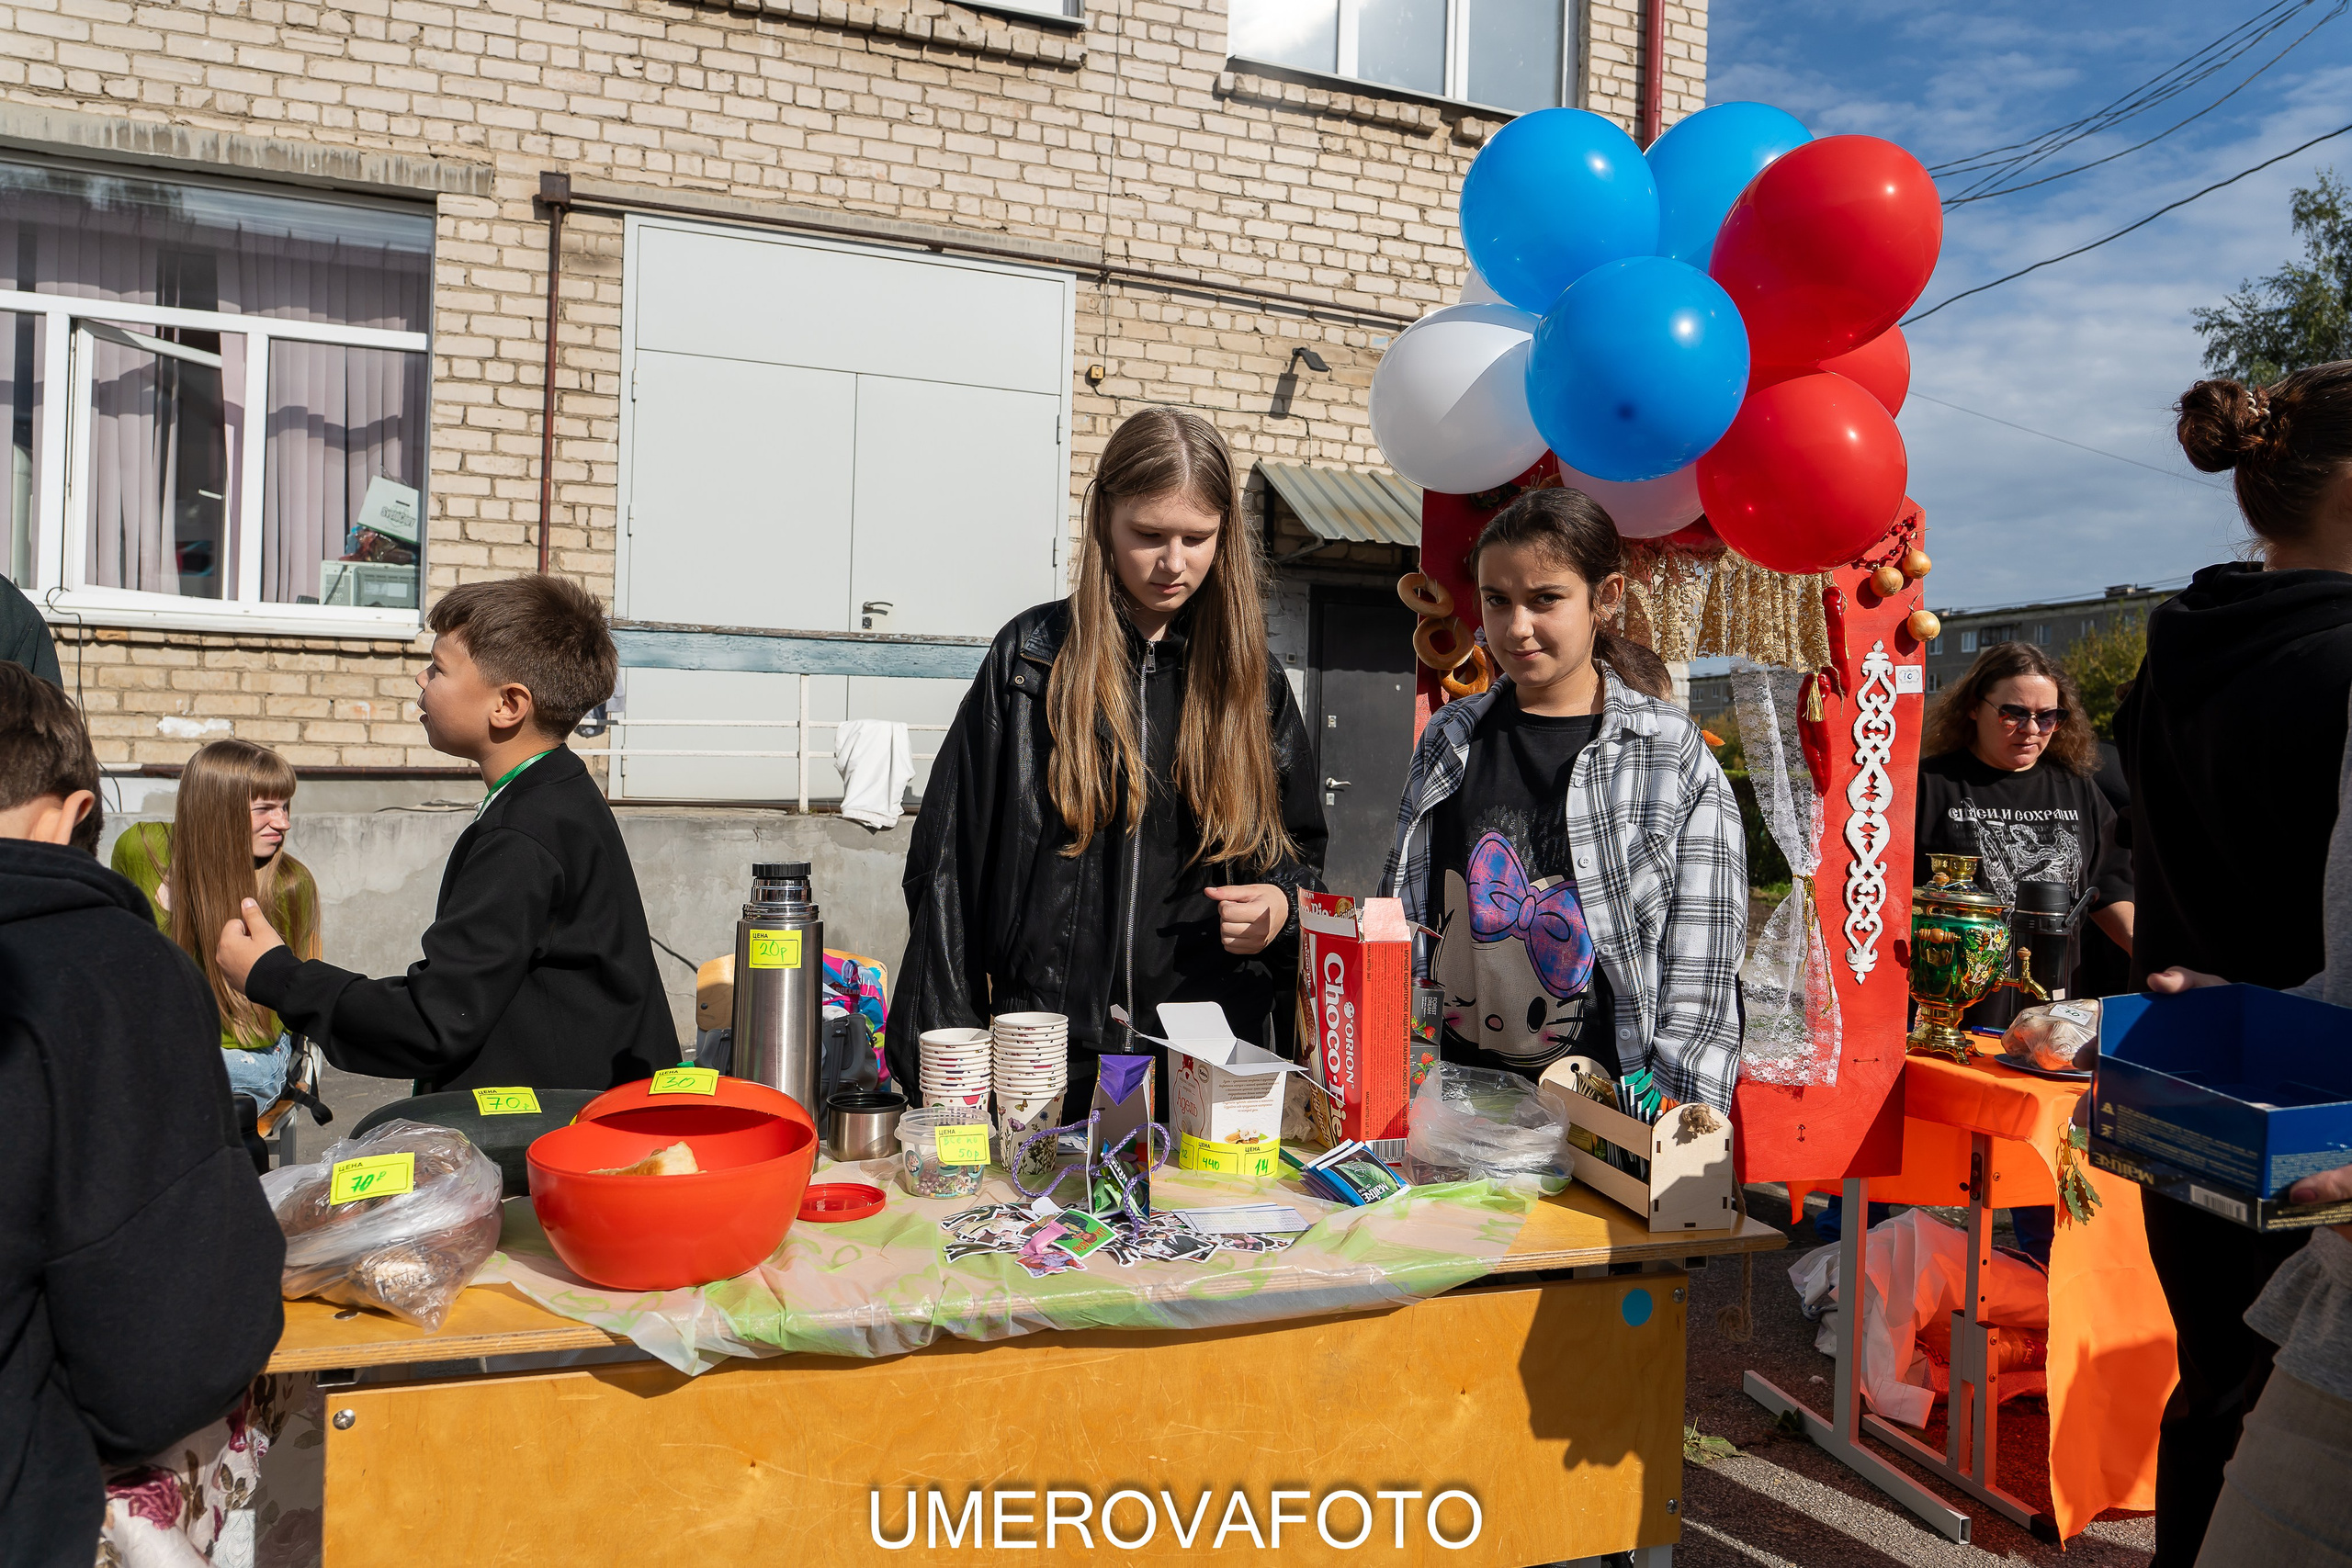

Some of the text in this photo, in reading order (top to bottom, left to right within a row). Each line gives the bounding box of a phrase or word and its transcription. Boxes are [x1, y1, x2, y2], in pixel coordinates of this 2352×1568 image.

[2001, 808, 2011, 820] И
[662, 1077, 696, 1089] 30
[338, 1162, 364, 1172] ЦЕНА
